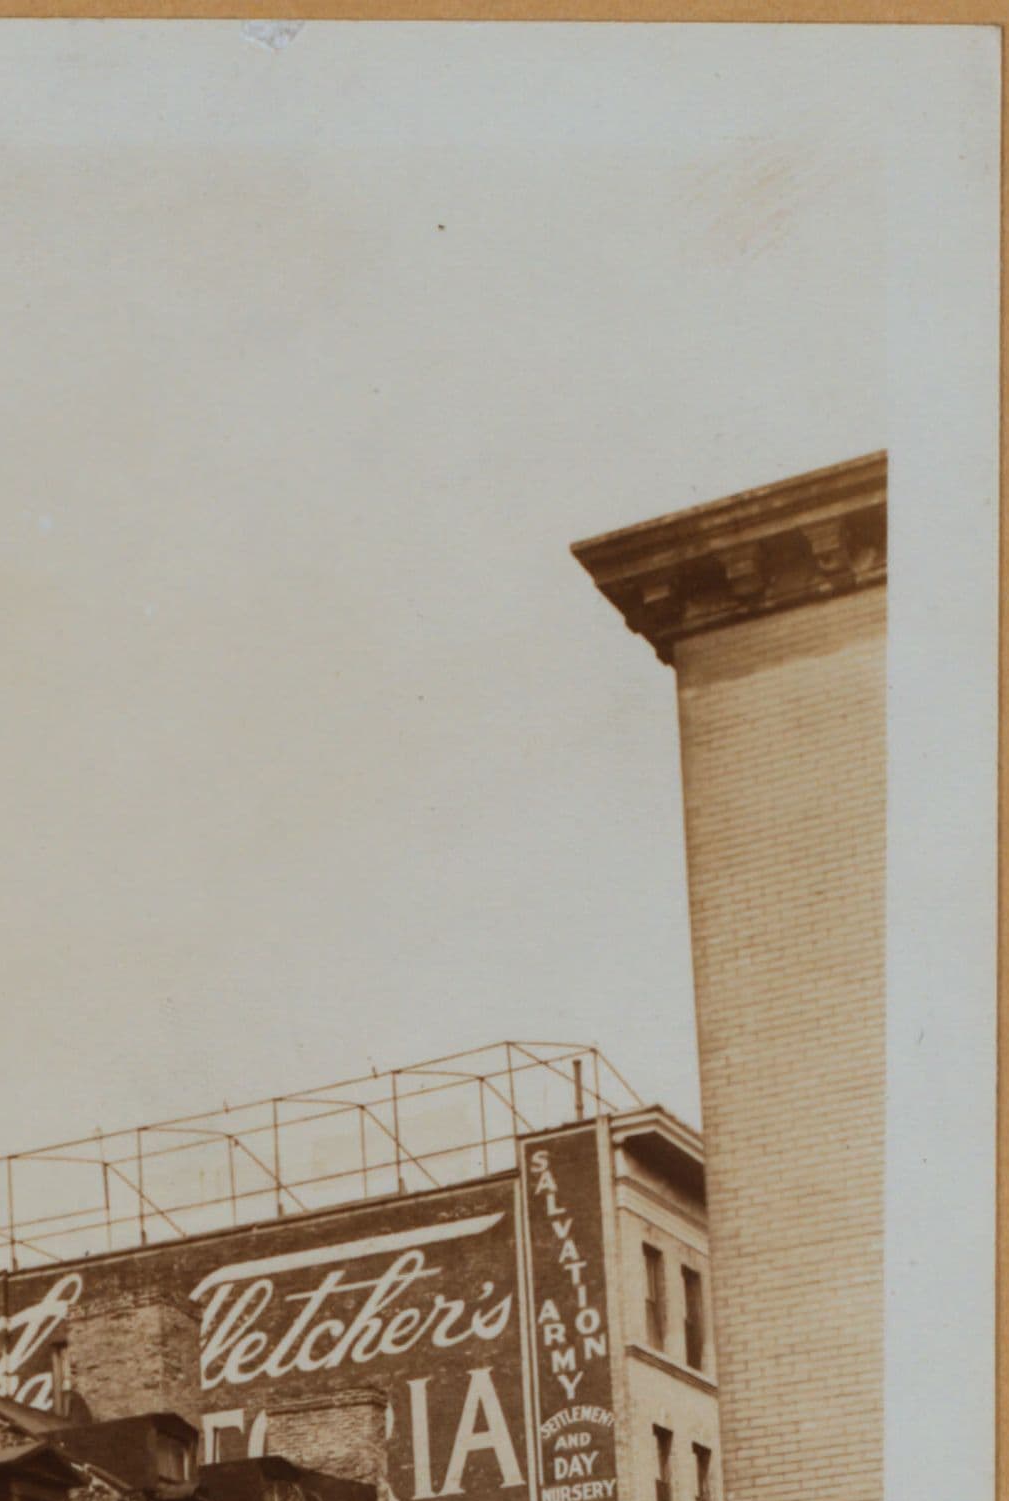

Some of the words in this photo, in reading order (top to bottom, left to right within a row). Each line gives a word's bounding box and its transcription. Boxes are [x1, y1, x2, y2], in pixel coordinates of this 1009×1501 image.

[530, 1149, 607, 1361] SALVATION
[537, 1299, 584, 1401] ARMY
[541, 1405, 616, 1440] SETTLEMENT
[554, 1432, 592, 1452] AND
[554, 1450, 600, 1481] DAY
